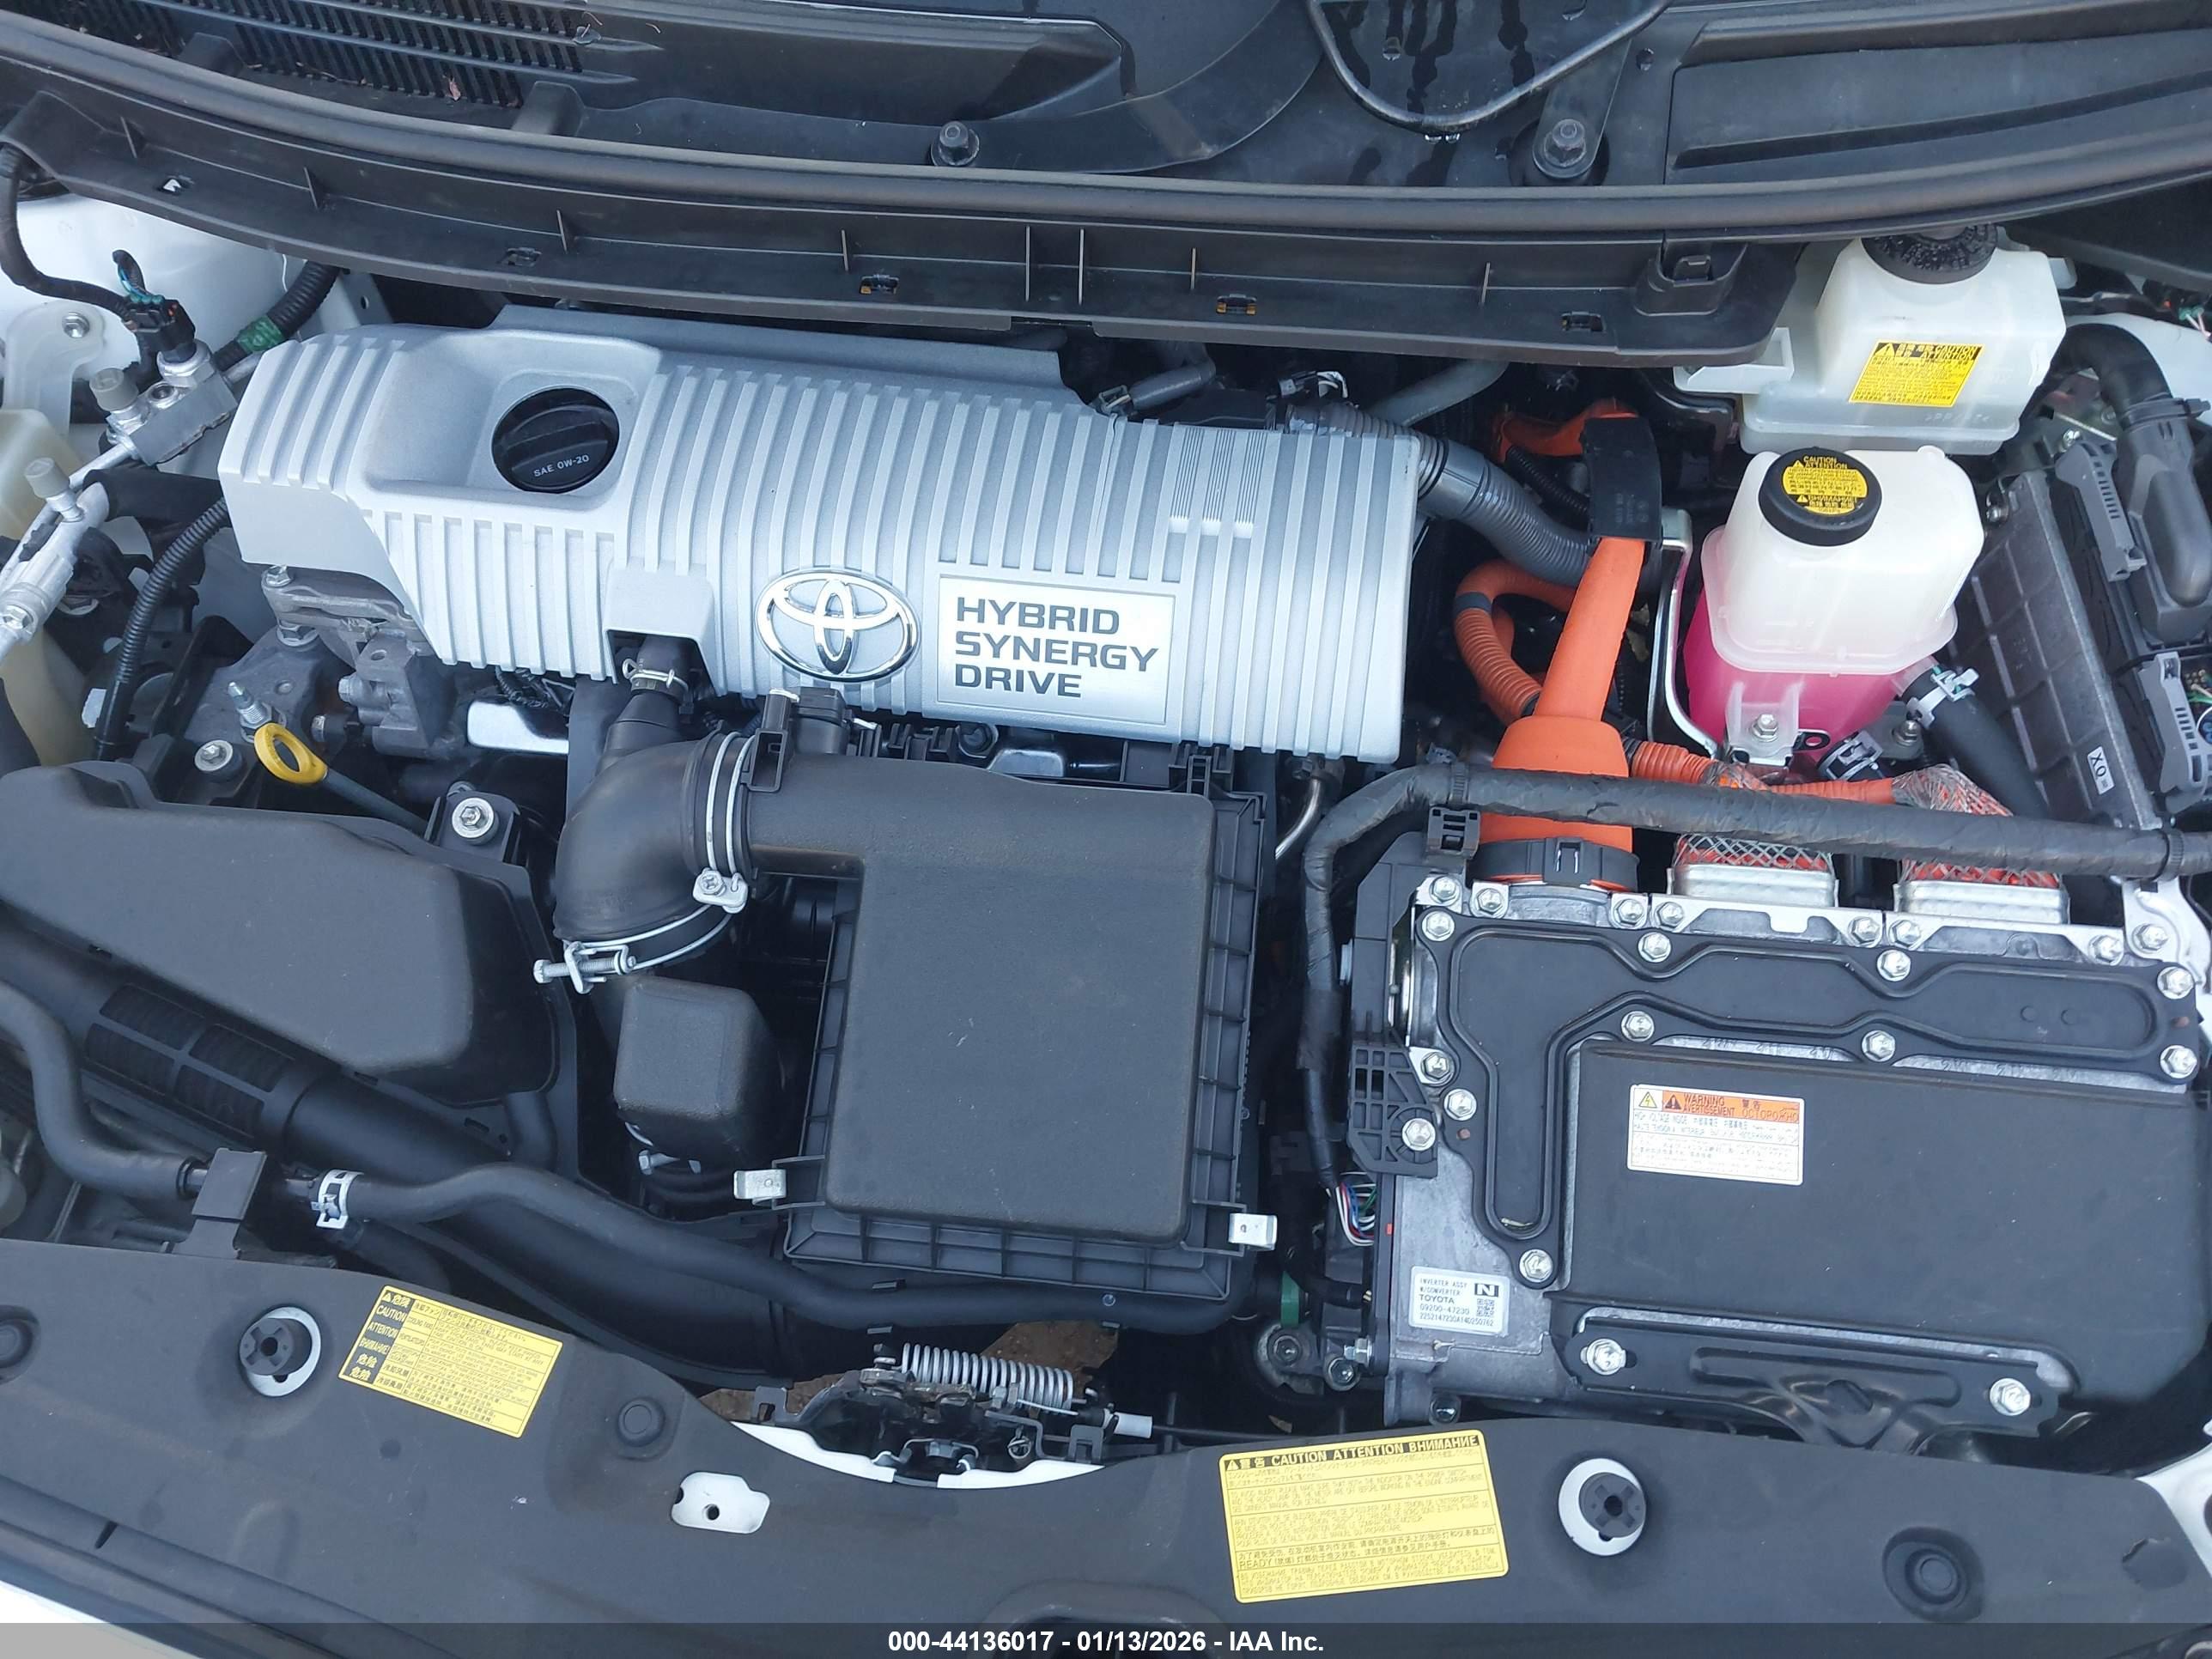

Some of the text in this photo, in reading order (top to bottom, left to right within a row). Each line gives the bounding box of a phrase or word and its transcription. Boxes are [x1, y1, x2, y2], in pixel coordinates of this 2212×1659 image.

[533, 454, 590, 477] SAE 0W-20
[957, 597, 1120, 635] HYBRID
[955, 630, 1159, 672] SYNERGY
[955, 663, 1082, 698] DRIVE
[1683, 1093, 1725, 1107] WARNING
[1683, 1104, 1735, 1116] AVERTISSEMENT
[1419, 1294, 1455, 1304] TOYOTA
[376, 1305, 408, 1322] CAUTION
[368, 1322, 399, 1339] ATTENTION
[1271, 1450, 1327, 1467] CAUTION
[1333, 1443, 1404, 1461] ATTENTION
